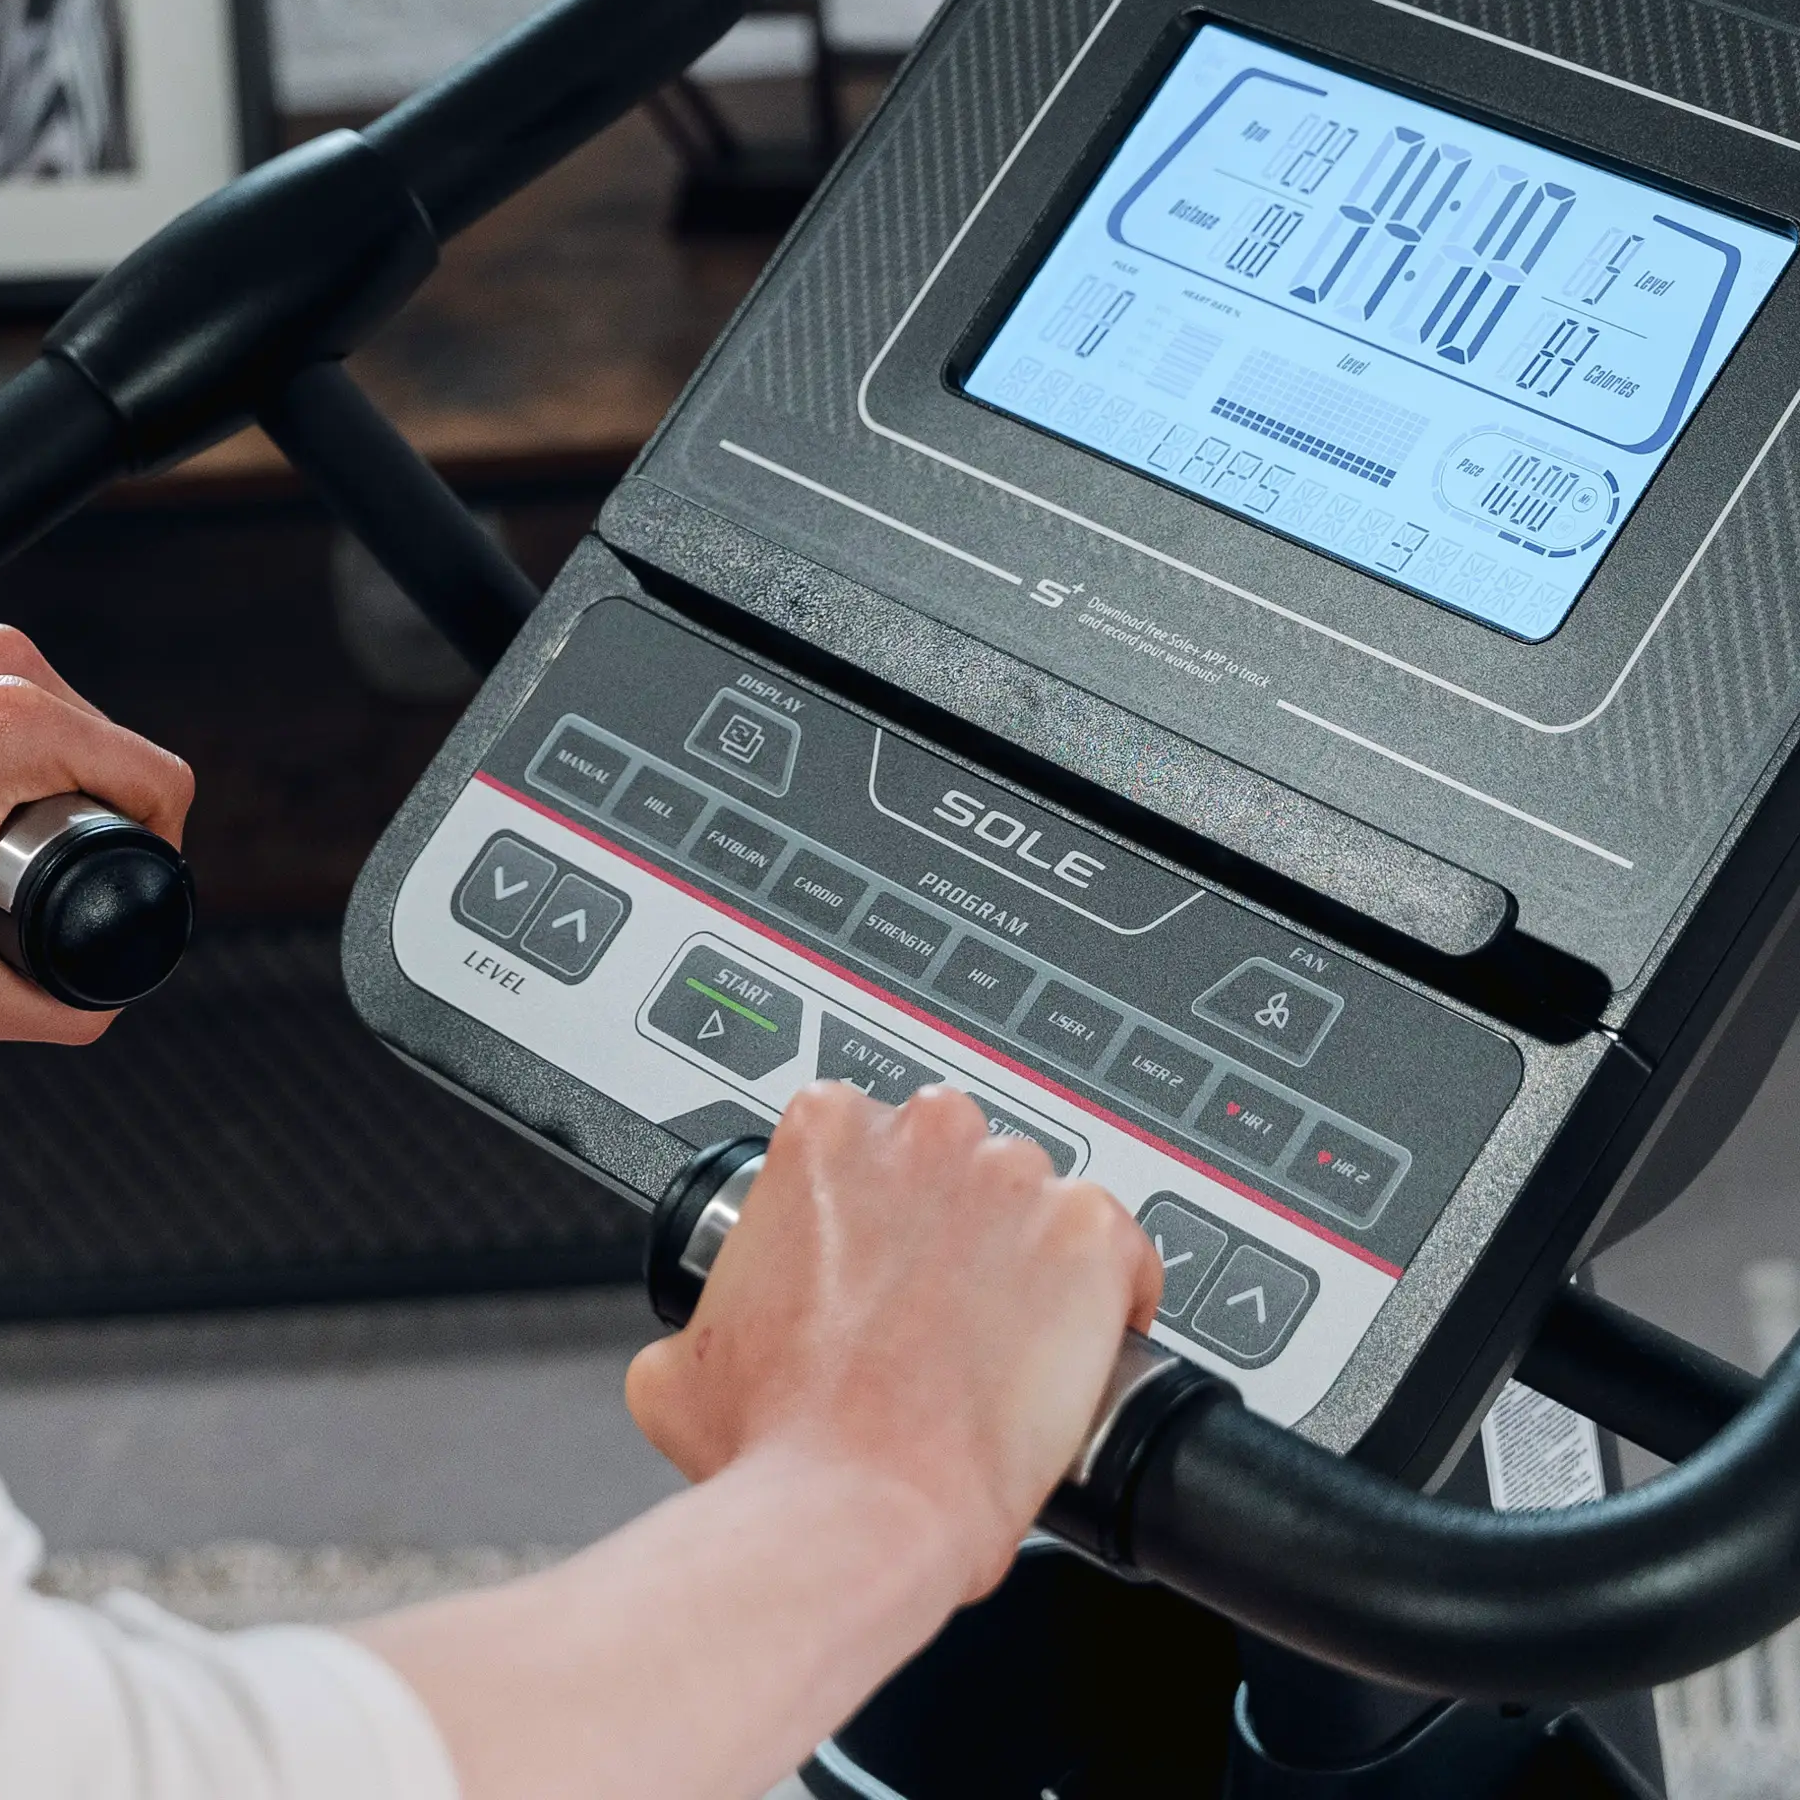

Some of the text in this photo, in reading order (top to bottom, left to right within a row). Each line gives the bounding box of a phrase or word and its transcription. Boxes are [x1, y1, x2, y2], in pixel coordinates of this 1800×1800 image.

[1168, 199, 1220, 230] Distance
[1288, 126, 1577, 365] 34:10
[1580, 234, 1646, 306] 5
[1633, 270, 1676, 297] Level
[1336, 353, 1371, 376] Level
[1582, 364, 1641, 399] Calories
[1147, 424, 1297, 515] LAPS
[1456, 457, 1485, 478] Pace
[1480, 455, 1580, 533] 10:00
[1078, 613, 1223, 684] and record your workouts!
[1087, 596, 1272, 688] Download free Sole+ APP to track
[735, 673, 805, 714] DISPLAY
[556, 749, 611, 785] MANUAL
[643, 796, 674, 819] HILL
[707, 830, 769, 869] FATBURN
[932, 789, 1106, 889] SOLE
[793, 876, 844, 908] CARDIO
[917, 871, 1030, 937] PROGRAM
[864, 914, 936, 958] STRENGTH
[463, 950, 526, 996] LEVEL
[1288, 947, 1330, 973] FAN
[713, 968, 773, 1006] START
[967, 968, 1000, 991] HIIT
[1048, 1011, 1096, 1042] USER 1
[842, 1039, 906, 1081] ENTER
[1132, 1054, 1185, 1089] USER 2
[1238, 1110, 1274, 1137] HR 1
[1331, 1158, 1371, 1186] HR 2
